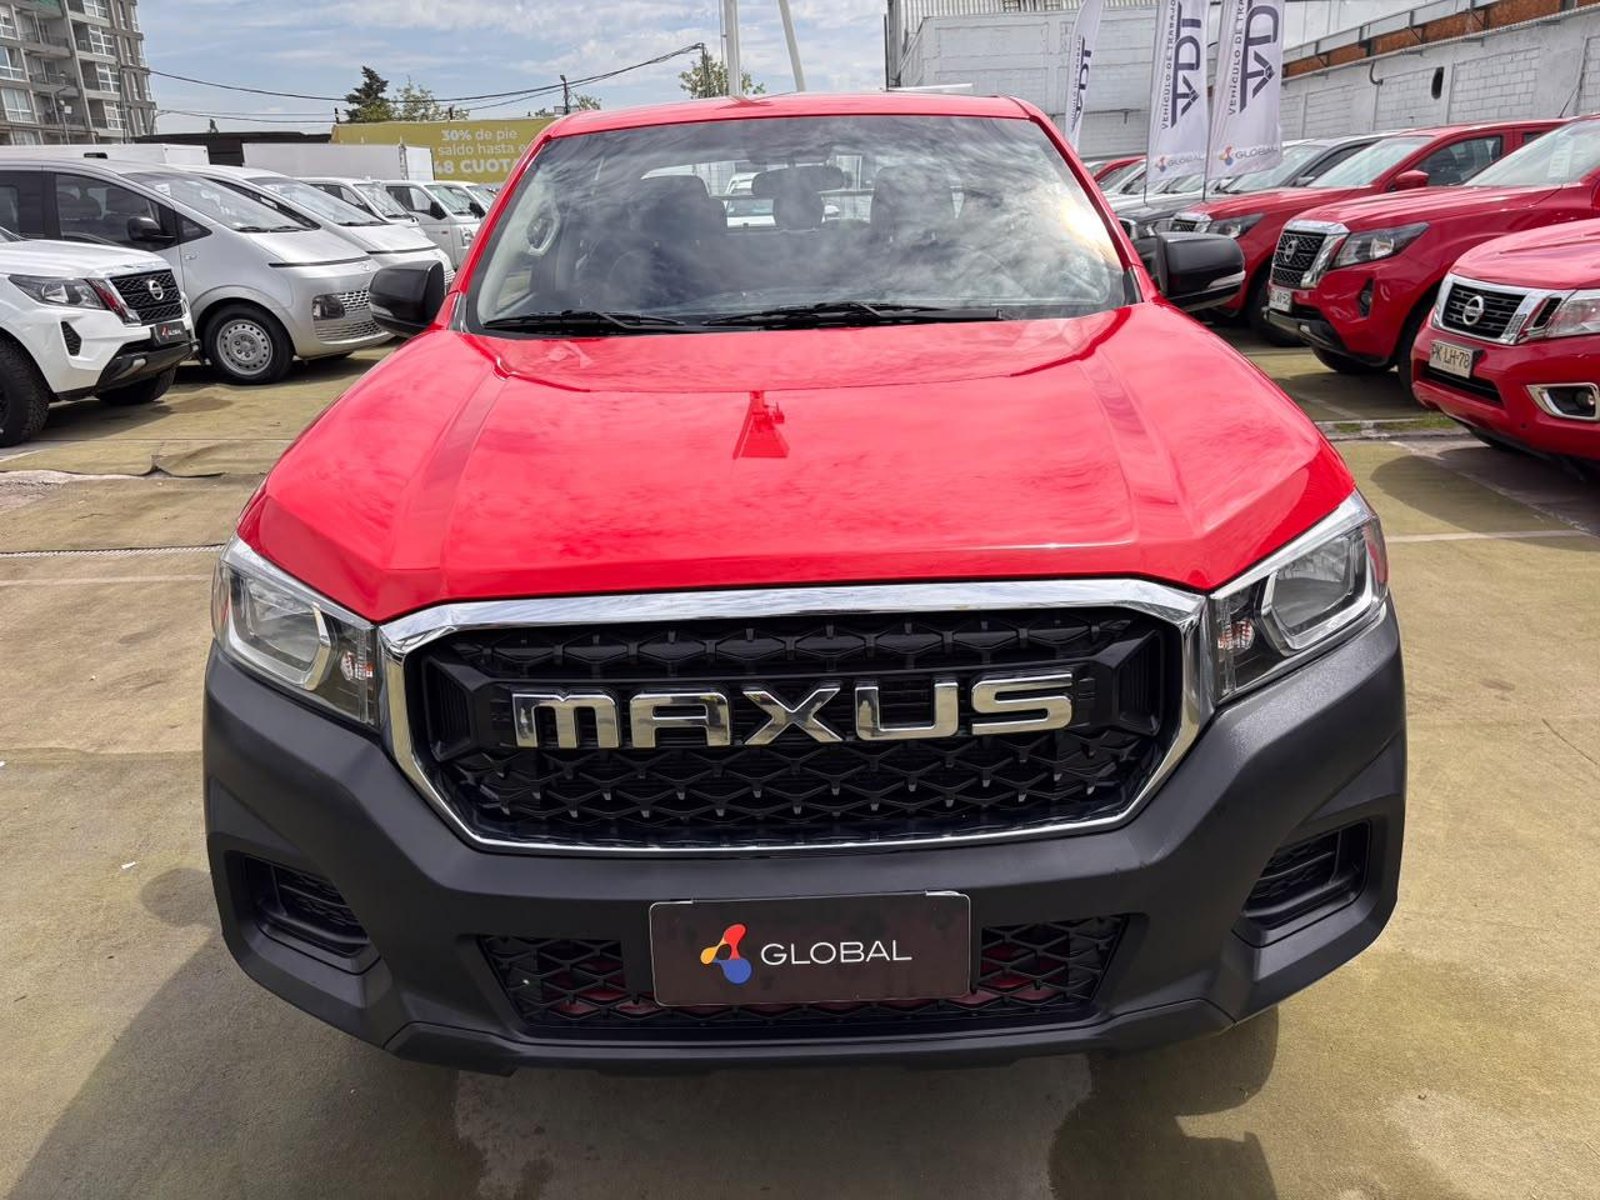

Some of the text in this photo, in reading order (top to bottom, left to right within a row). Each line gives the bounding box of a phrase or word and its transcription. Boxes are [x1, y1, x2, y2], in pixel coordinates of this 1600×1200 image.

[442, 127, 518, 141] 30% de pie
[438, 144, 474, 156] saldo
[478, 143, 515, 154] hasta
[511, 671, 1073, 749] MAXUS
[760, 939, 913, 966] GLOBAL
